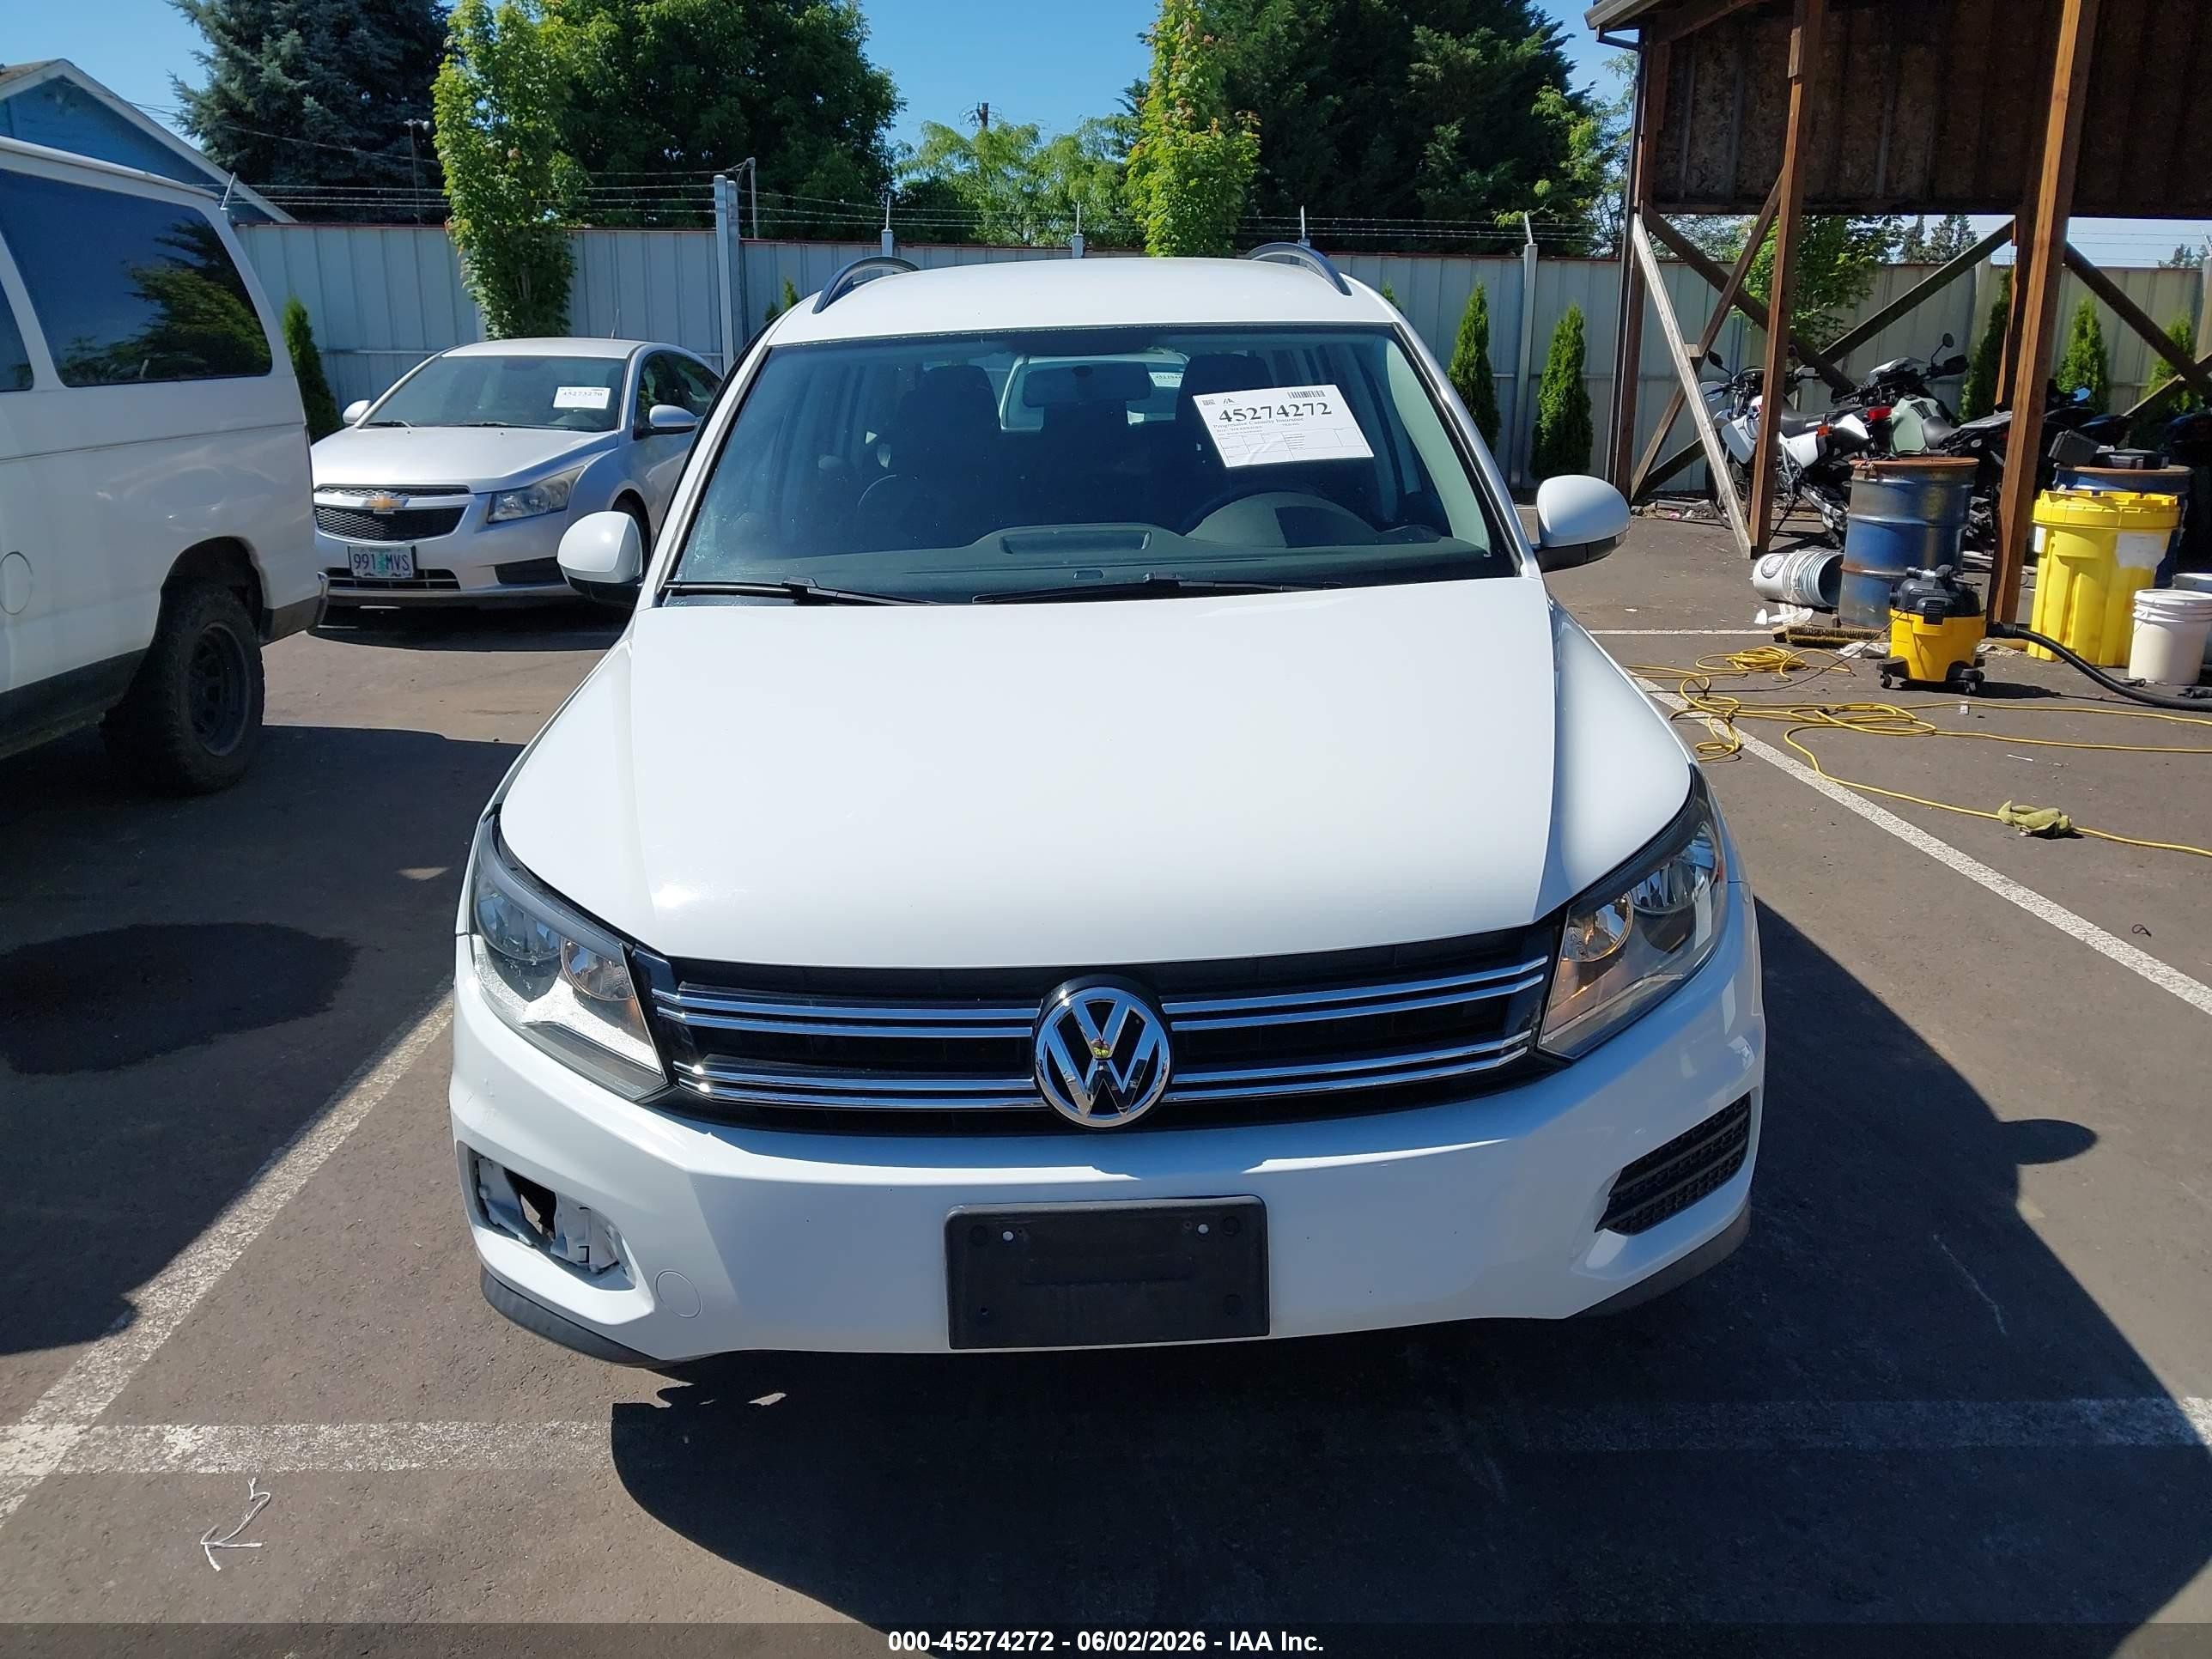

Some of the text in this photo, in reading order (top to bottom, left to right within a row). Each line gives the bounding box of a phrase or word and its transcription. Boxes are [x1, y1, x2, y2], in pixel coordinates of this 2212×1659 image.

[1218, 402, 1333, 422] 45274272
[1212, 422, 1248, 430] Progressive
[353, 553, 410, 571] 991 MVS
